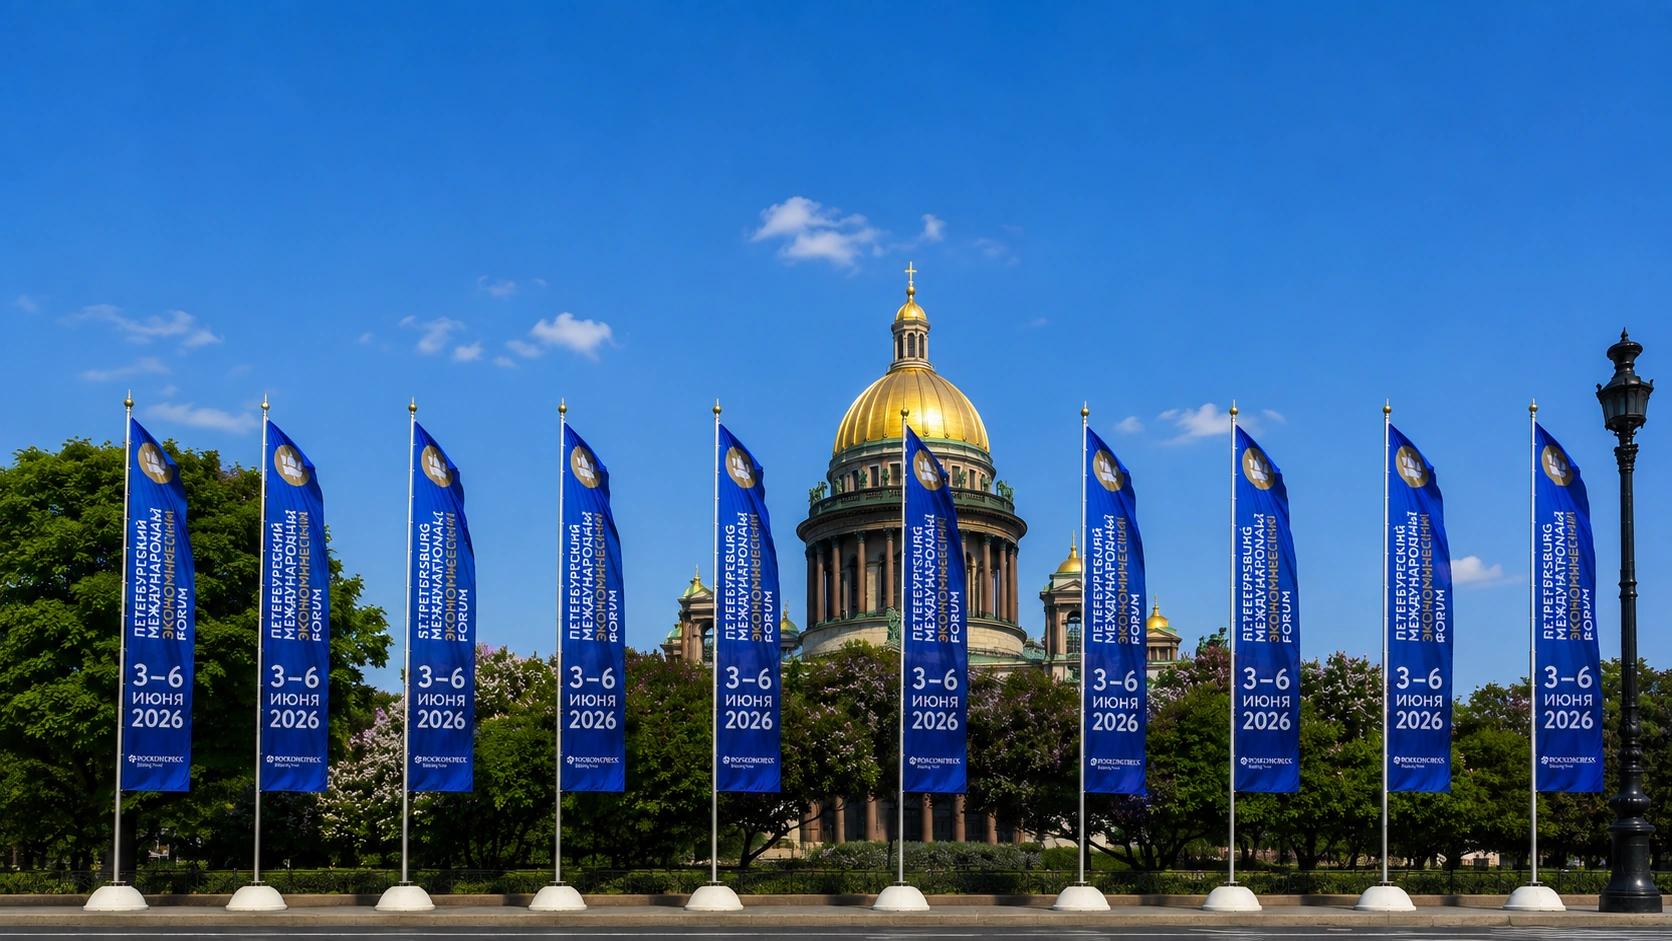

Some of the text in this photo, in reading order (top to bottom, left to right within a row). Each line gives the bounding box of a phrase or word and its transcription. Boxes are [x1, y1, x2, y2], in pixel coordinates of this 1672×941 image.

[458, 589, 468, 642] FORUM
[764, 591, 774, 642] FORUM
[950, 591, 960, 643] FORUM
[1282, 591, 1292, 643] FORUM
[133, 693, 183, 705] ИЮНЯ
[271, 694, 319, 705] ИЮНЯ
[419, 694, 465, 706] ИЮНЯ
[570, 694, 615, 706] ИЮНЯ
[726, 695, 771, 706] ИЮНЯ
[913, 696, 958, 707] ИЮНЯ
[1094, 697, 1137, 708] ИЮНЯ
[1244, 696, 1289, 707] ИЮНЯ
[1397, 695, 1442, 707] ИЮНЯ
[1545, 694, 1592, 706] ИЮНЯ
[132, 709, 182, 728] 2026
[271, 710, 319, 728] 2026
[418, 710, 465, 729] 2026
[570, 710, 616, 729] 2026
[726, 711, 772, 729] 2026
[913, 711, 958, 730] 2026
[1093, 713, 1138, 732] 2026
[1244, 712, 1290, 730] 2026
[1396, 711, 1442, 729] 2026
[1545, 711, 1593, 728] 2026
